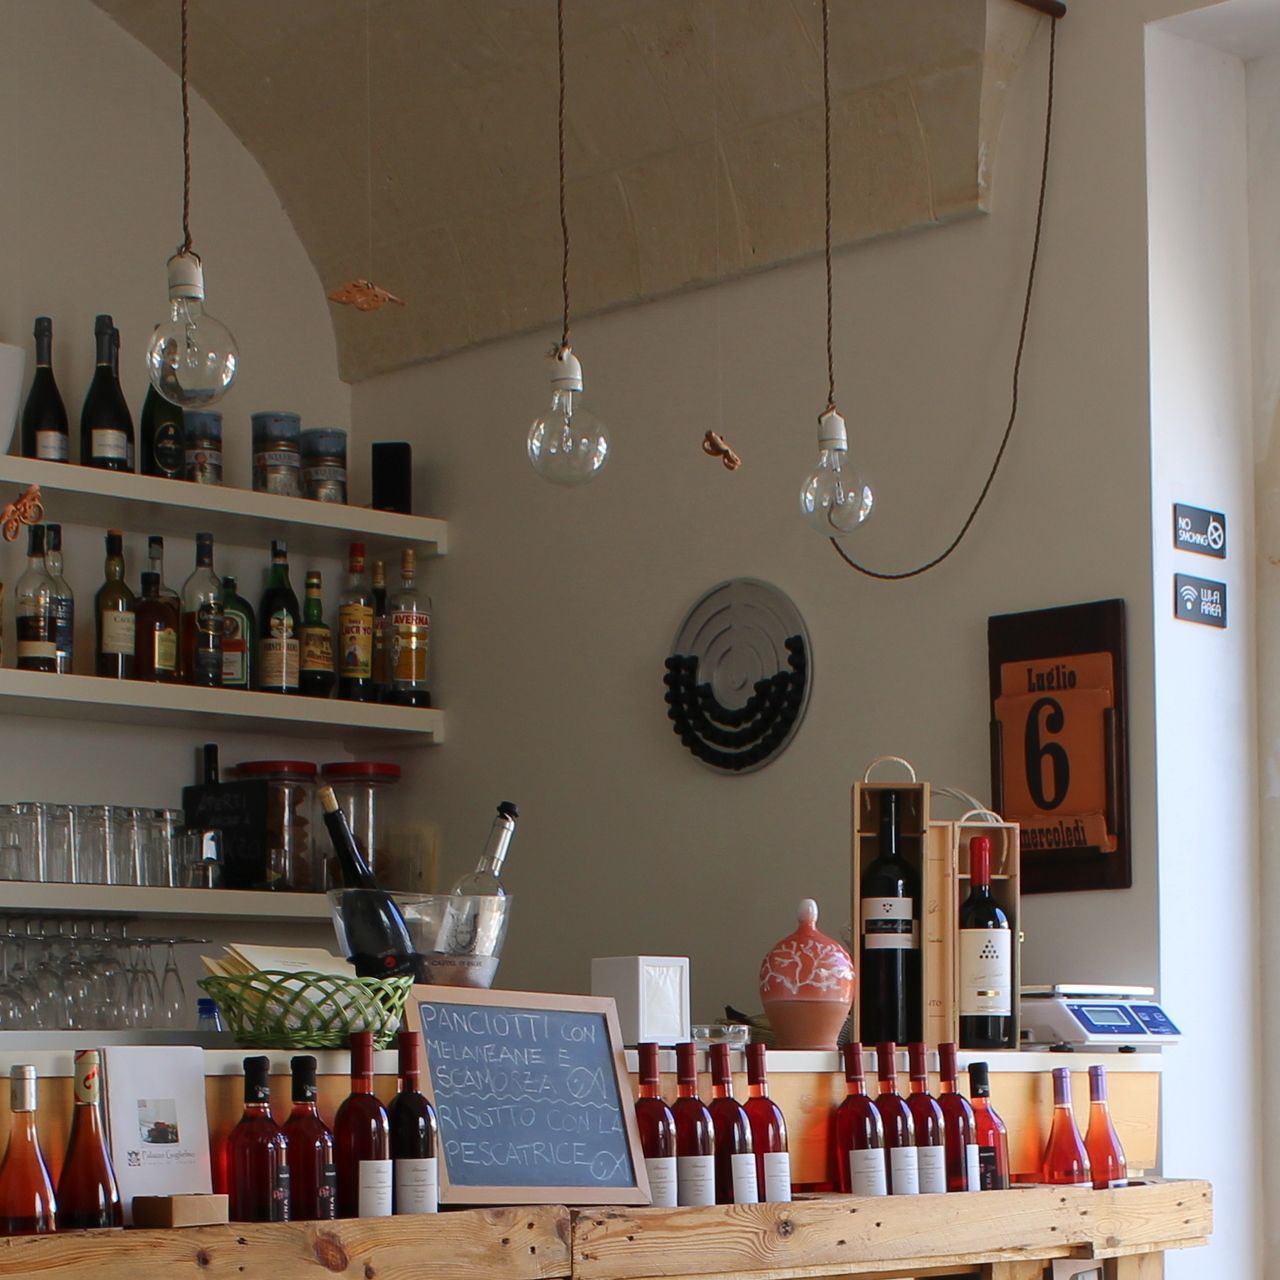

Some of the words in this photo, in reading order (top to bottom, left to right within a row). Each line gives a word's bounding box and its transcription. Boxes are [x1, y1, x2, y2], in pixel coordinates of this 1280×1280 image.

[1178, 516, 1192, 530] NO
[1178, 530, 1209, 546] SMOKING
[393, 614, 430, 626] AVERNA
[1201, 602, 1222, 618] AREA
[1027, 667, 1077, 692] Luglio
[1024, 697, 1070, 811] 6
[419, 1004, 549, 1042] PANCIOTTI
[561, 1025, 596, 1044] CON
[558, 1048, 571, 1067] E
[436, 1065, 558, 1095] SCAMORZA
[437, 1104, 536, 1131] RISOTTO
[547, 1109, 590, 1133] CON
[598, 1113, 623, 1135] LA
[444, 1141, 593, 1168] PESCATRICE
